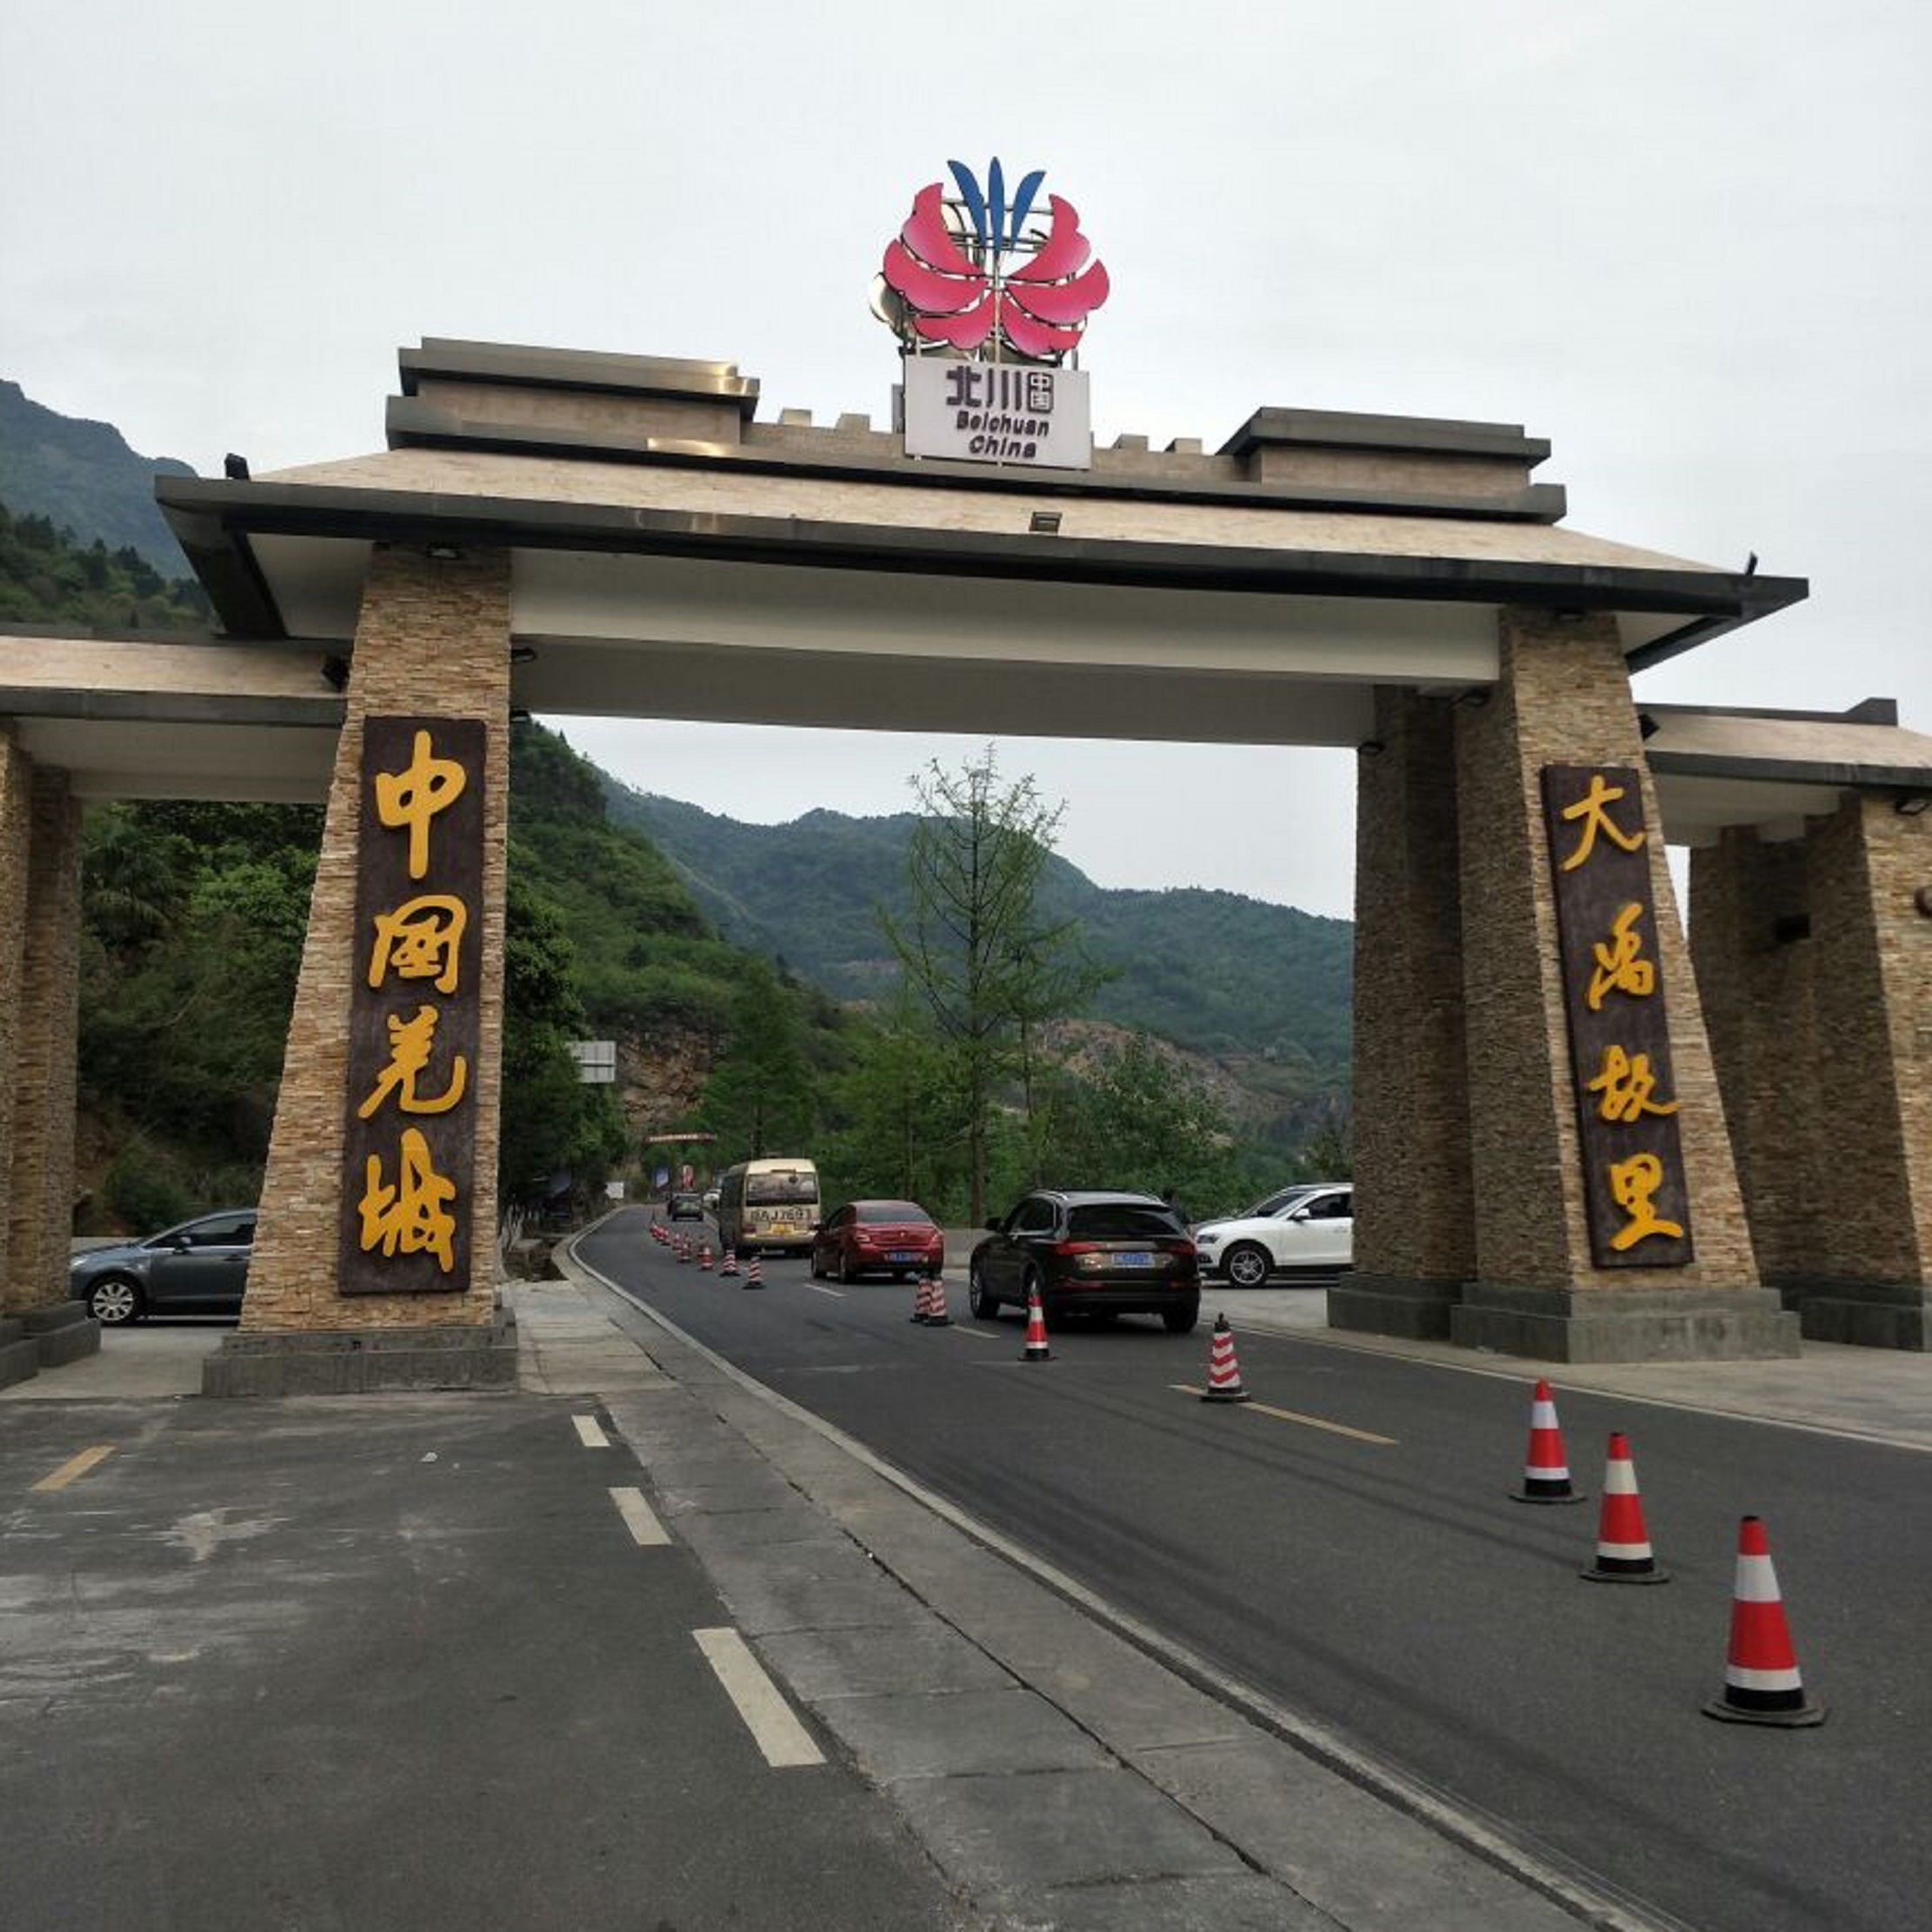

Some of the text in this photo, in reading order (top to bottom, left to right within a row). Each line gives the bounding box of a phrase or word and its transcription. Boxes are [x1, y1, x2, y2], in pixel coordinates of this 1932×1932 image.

[946, 365, 1023, 411] 北川
[956, 410, 1049, 436] Beichuan
[969, 436, 1037, 458] China
[1563, 774, 1683, 1252] 大禹故里
